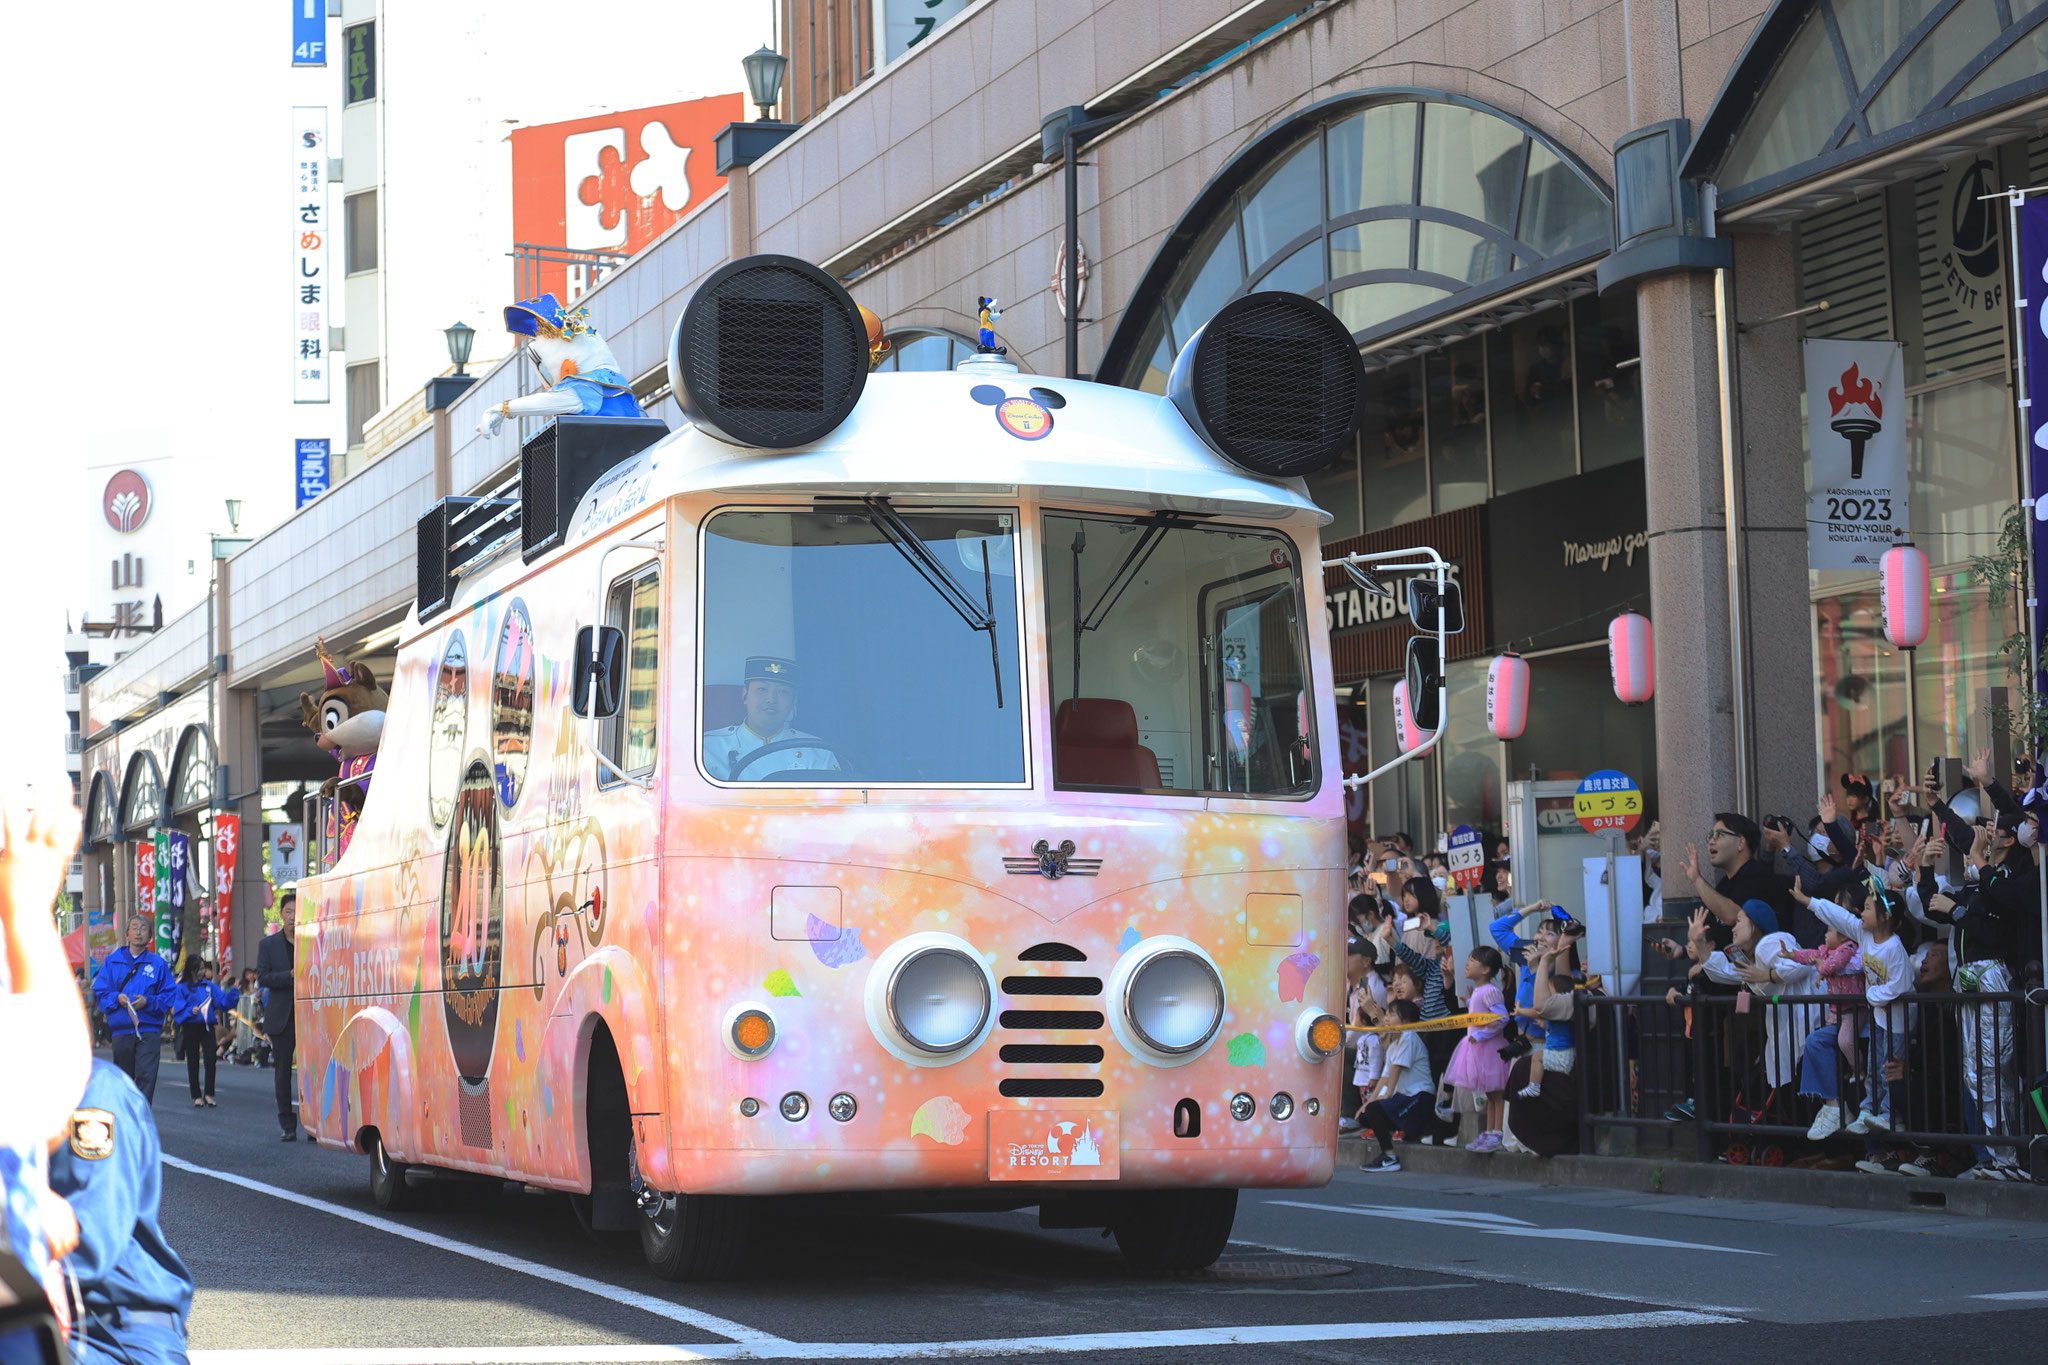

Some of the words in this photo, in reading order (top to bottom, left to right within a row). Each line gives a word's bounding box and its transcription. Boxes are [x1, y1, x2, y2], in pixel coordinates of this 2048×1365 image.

[295, 41, 324, 58] 4F
[350, 25, 369, 101] TRY
[300, 203, 321, 360] さめしま眼科
[1942, 252, 1978, 309] PETIT
[300, 449, 326, 505] つるや
[1827, 488, 1871, 496] KAGOSHIMA
[1873, 488, 1892, 496] CITY
[1827, 498, 1892, 521] 2023
[1828, 523, 1860, 533] ENJOY
[1863, 523, 1892, 533] YOUR
[1563, 536, 1622, 572] Maruya
[111, 553, 144, 662] 山形
[1326, 565, 1460, 631] STARBU
[1584, 777, 1630, 791] 鹿児島交通
[1579, 797, 1637, 812] いづろ
[1593, 816, 1625, 827] のりば
[1451, 849, 1481, 866] いづろ
[1456, 868, 1479, 881] のりば
[353, 948, 399, 1006] RESORT
[1010, 1156, 1069, 1166] RESORT
